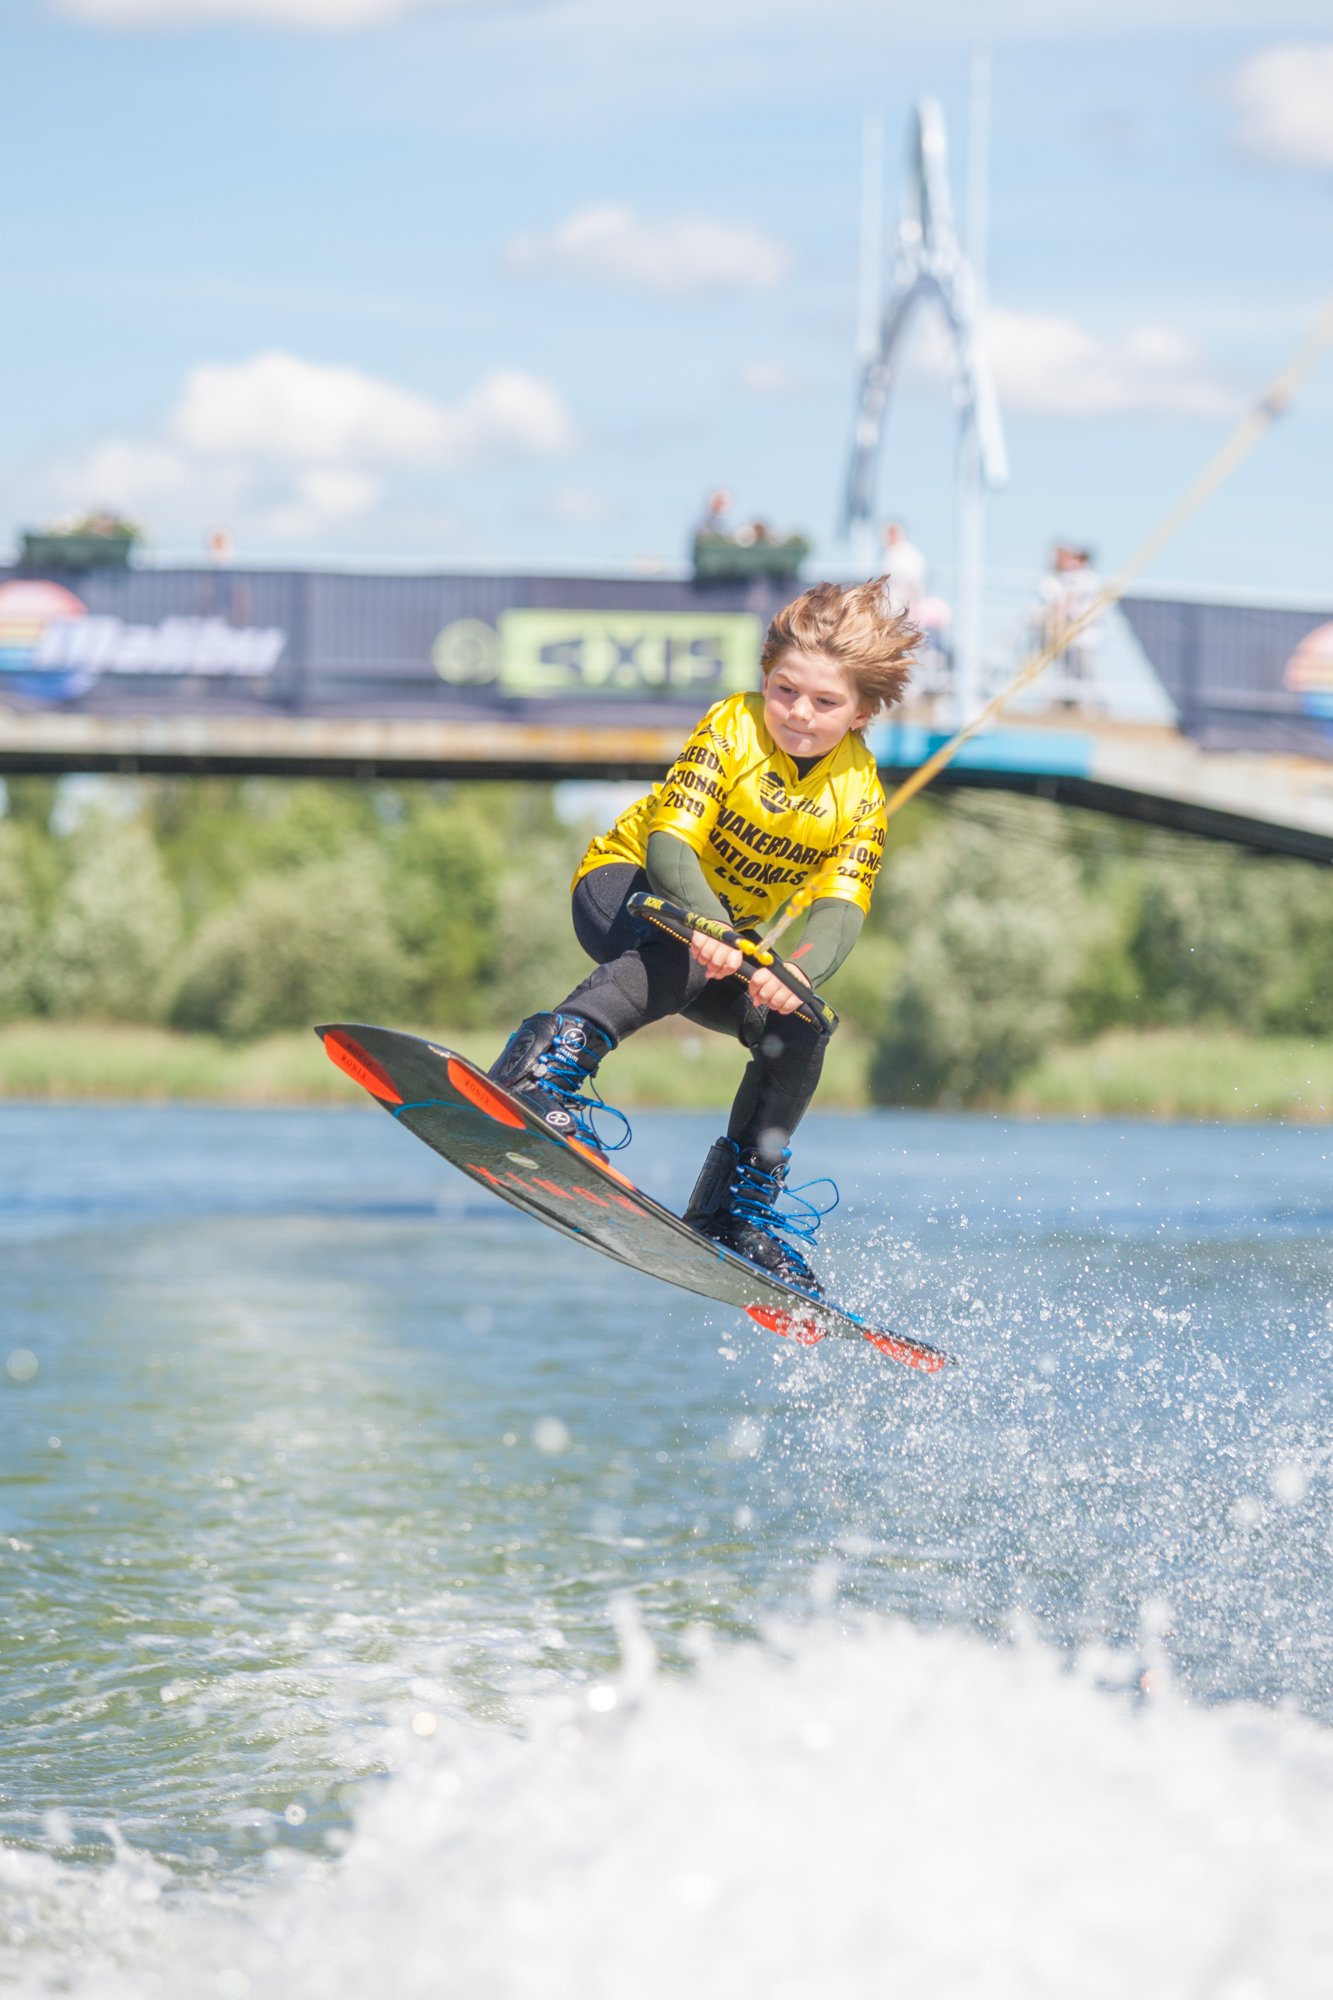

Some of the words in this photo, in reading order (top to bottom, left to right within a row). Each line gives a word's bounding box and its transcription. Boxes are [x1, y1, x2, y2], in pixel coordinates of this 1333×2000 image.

[663, 790, 706, 819] 2019
[341, 1053, 368, 1082] RONIX
[464, 1079, 490, 1106] RONIX
